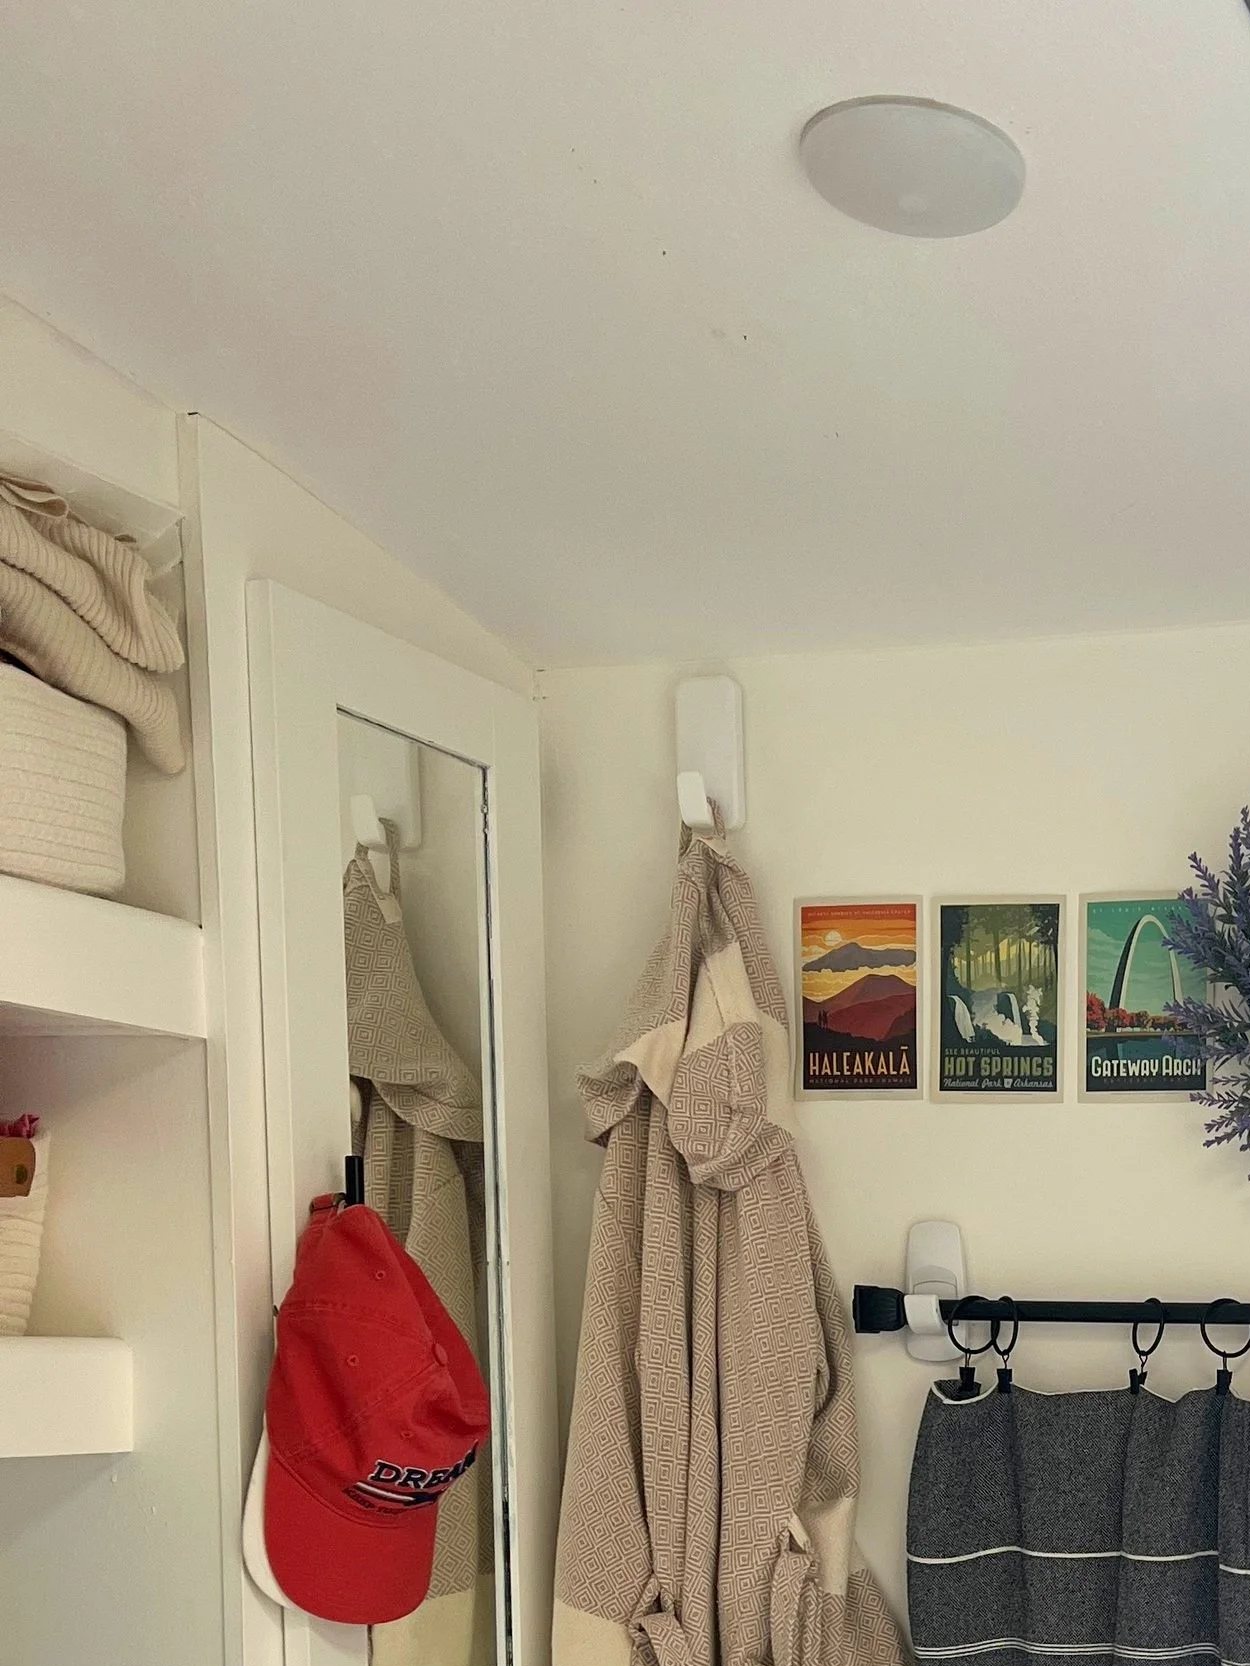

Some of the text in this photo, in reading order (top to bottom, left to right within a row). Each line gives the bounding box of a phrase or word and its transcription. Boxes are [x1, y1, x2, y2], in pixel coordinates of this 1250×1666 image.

[960, 1047, 1001, 1055] BEAUTIFUL
[809, 1046, 911, 1076] HALEAKALĀ
[944, 1056, 1054, 1077] HOT SPRINGS
[943, 1077, 1054, 1089] National Park Arkansas
